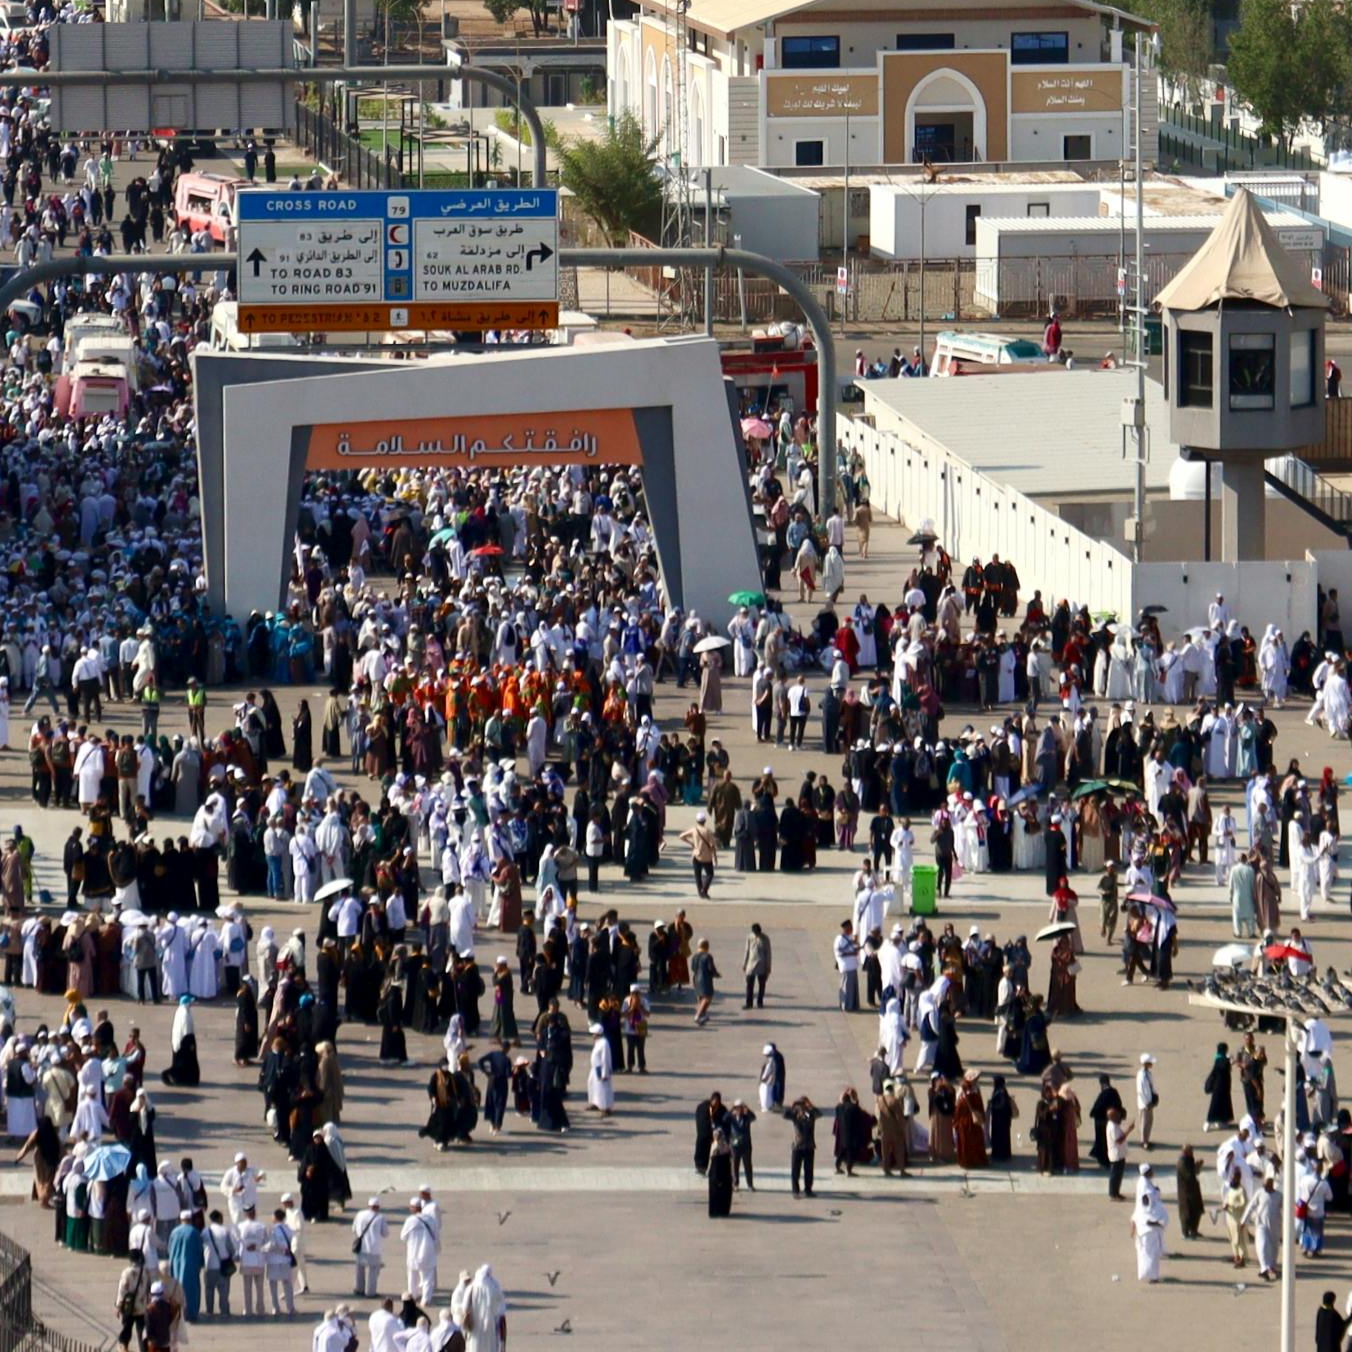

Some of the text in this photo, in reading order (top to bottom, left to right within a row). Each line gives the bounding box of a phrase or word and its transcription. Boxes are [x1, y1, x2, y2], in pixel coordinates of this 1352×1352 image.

[266, 199, 357, 211] CROSS ROAD
[391, 206, 406, 215] 79
[440, 197, 540, 215] الطريق العرضي
[317, 229, 353, 244] طريق
[358, 229, 378, 244] إلى
[433, 223, 524, 237] طريق سوق العرب
[330, 249, 361, 264] الطريق
[363, 249, 378, 263] إلى
[460, 244, 501, 258] مزدلفة
[506, 244, 525, 259] إلى
[279, 255, 289, 263] 91
[270, 268, 353, 279] TO ROAD 83
[423, 264, 451, 275] SOUK
[455, 264, 469, 275] AL
[472, 264, 502, 275] ARAB
[271, 283, 376, 295] TO RING ROAD 91
[423, 280, 511, 291] TO MUZDALIFA
[262, 313, 276, 324] TO
[477, 311, 511, 324] طريق
[515, 309, 535, 324] إلى
[337, 429, 598, 460] رافقتكم السلامة
